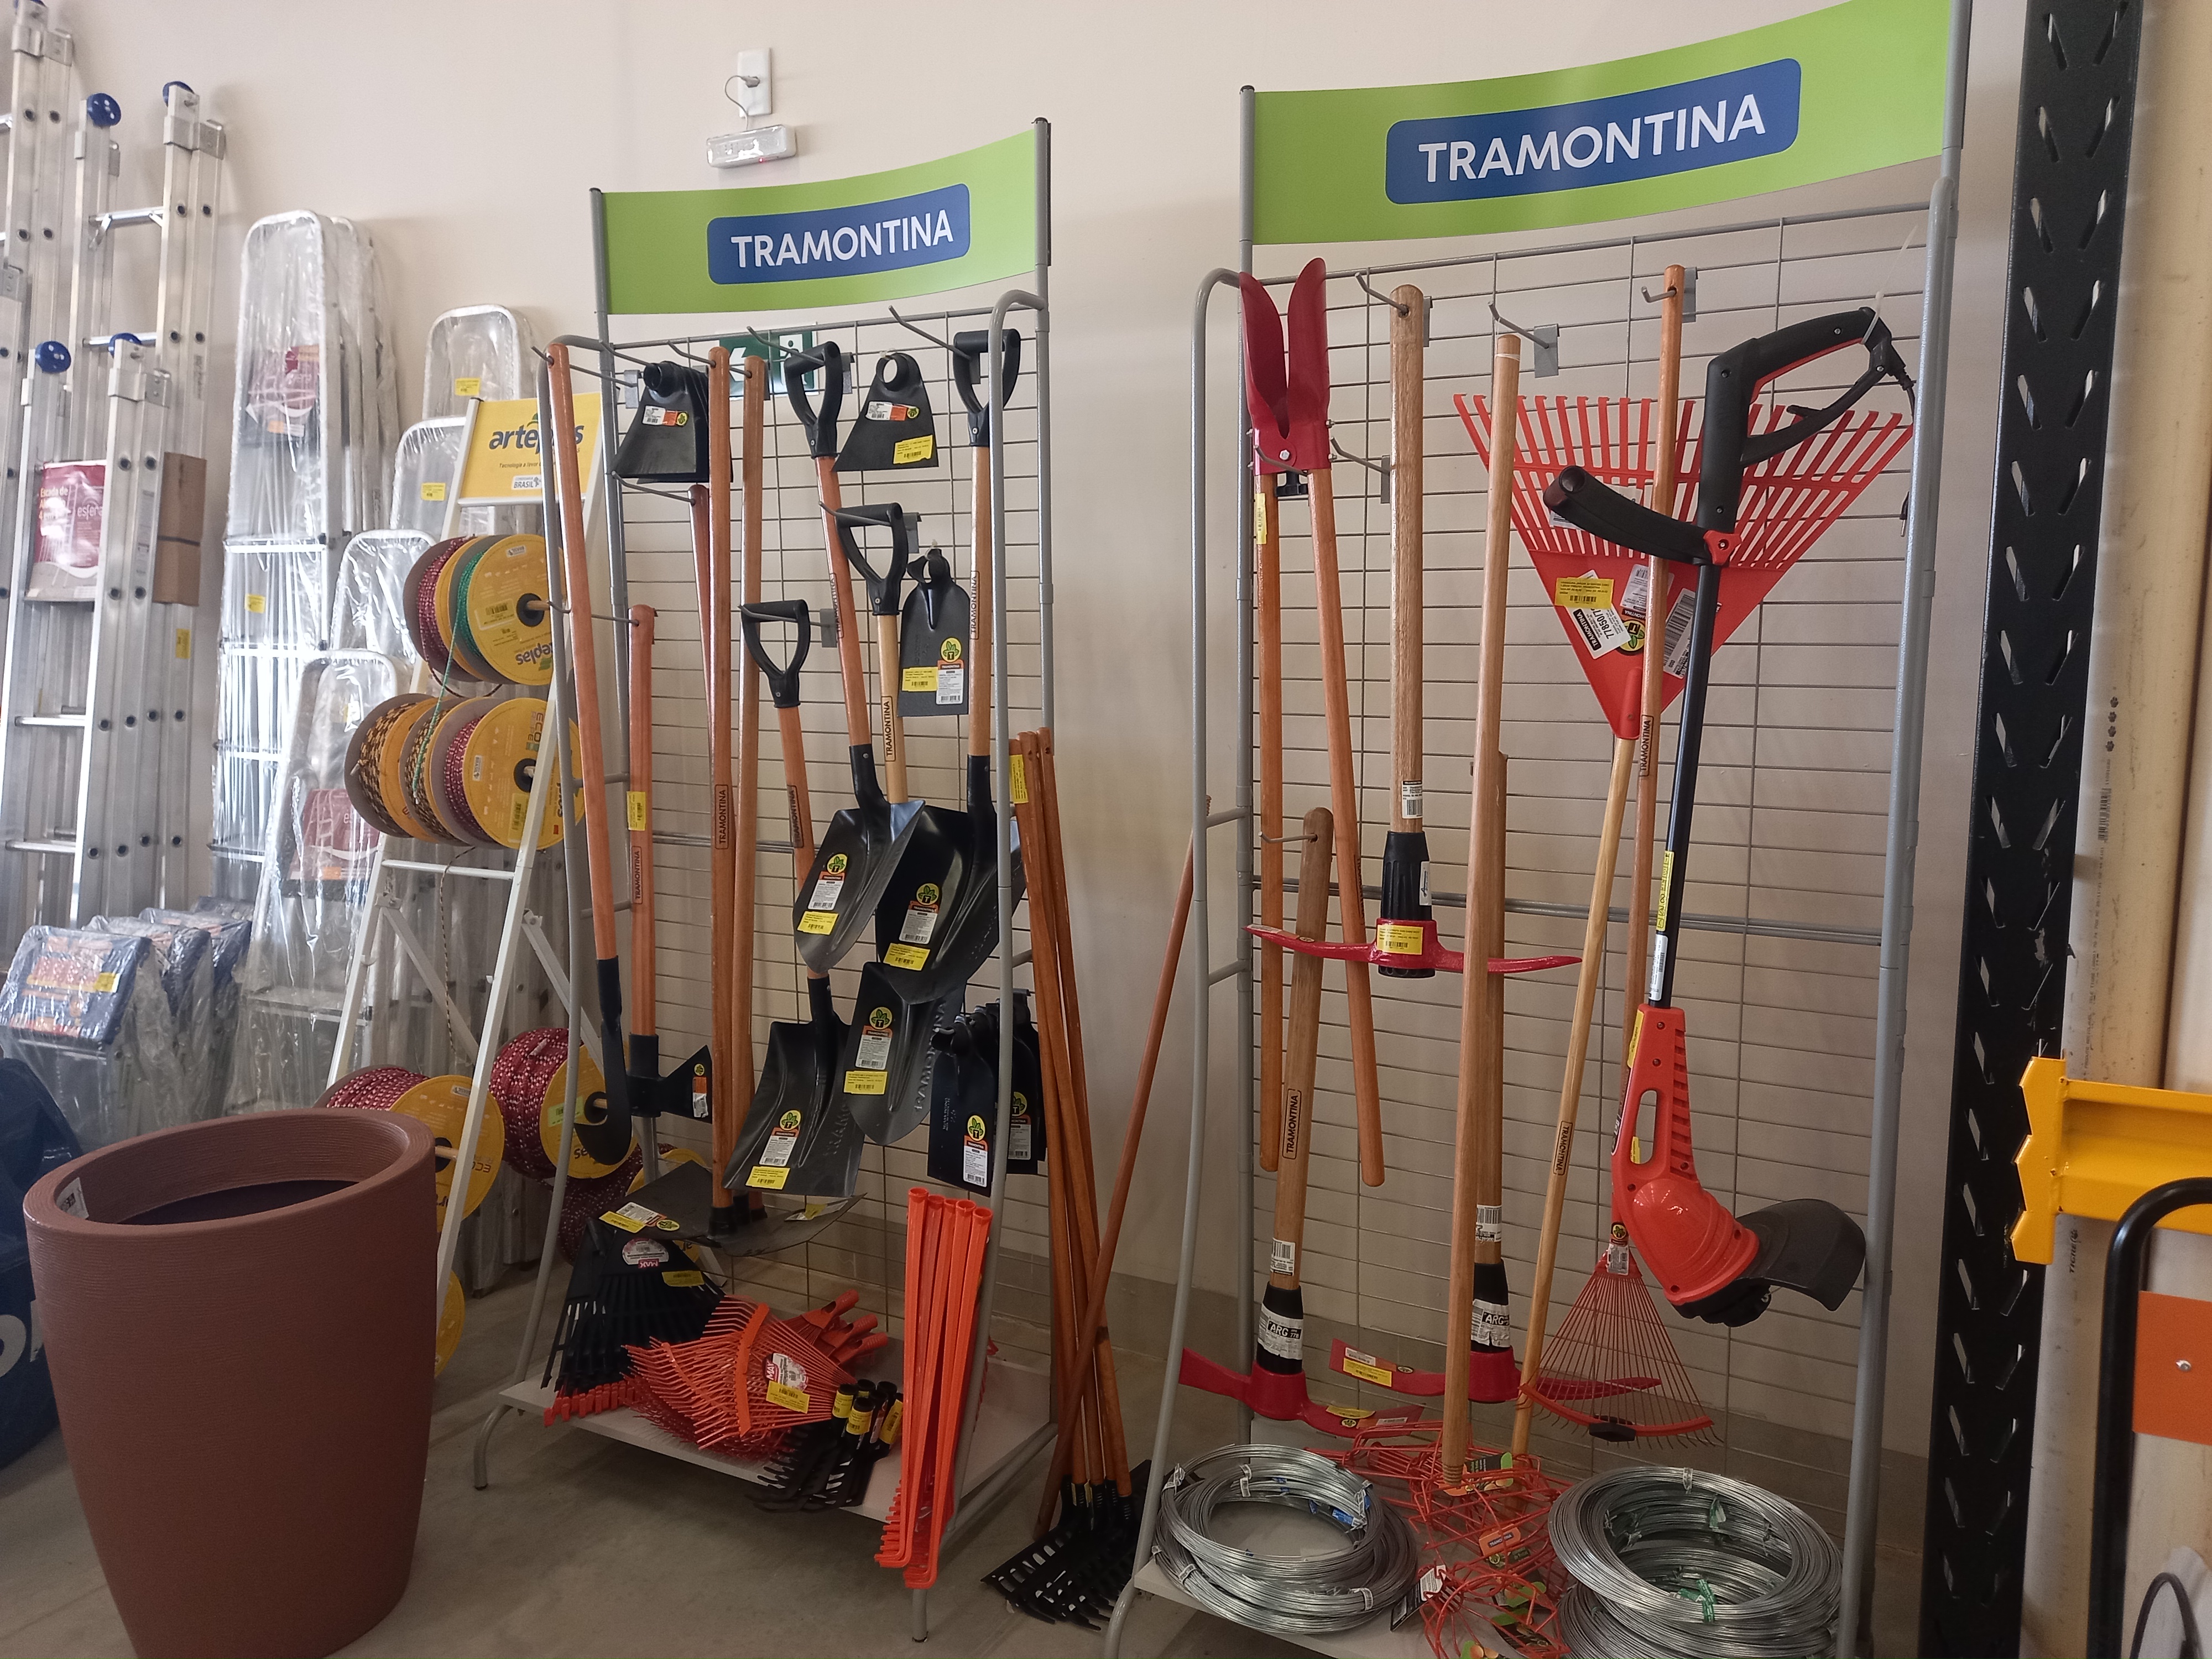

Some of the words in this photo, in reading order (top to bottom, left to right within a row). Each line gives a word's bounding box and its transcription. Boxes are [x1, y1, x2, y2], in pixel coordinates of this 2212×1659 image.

[1418, 93, 1766, 183] TRAMONTINA
[731, 209, 954, 268] TRAMONTINA
[513, 480, 534, 488] BRASIL
[1576, 611, 1599, 647] TRAMONTINA
[534, 712, 543, 742] ECO
[884, 701, 893, 757] TRAMONTINA
[1640, 720, 1651, 771] TRAMONTINA
[789, 790, 800, 842] TRAMONTINA
[1286, 1095, 1298, 1153] TRAMONTINA
[1555, 1126, 1569, 1171] TRAMONTINA
[1270, 1323, 1289, 1337] ARG
[1485, 1314, 1504, 1325] ARG
